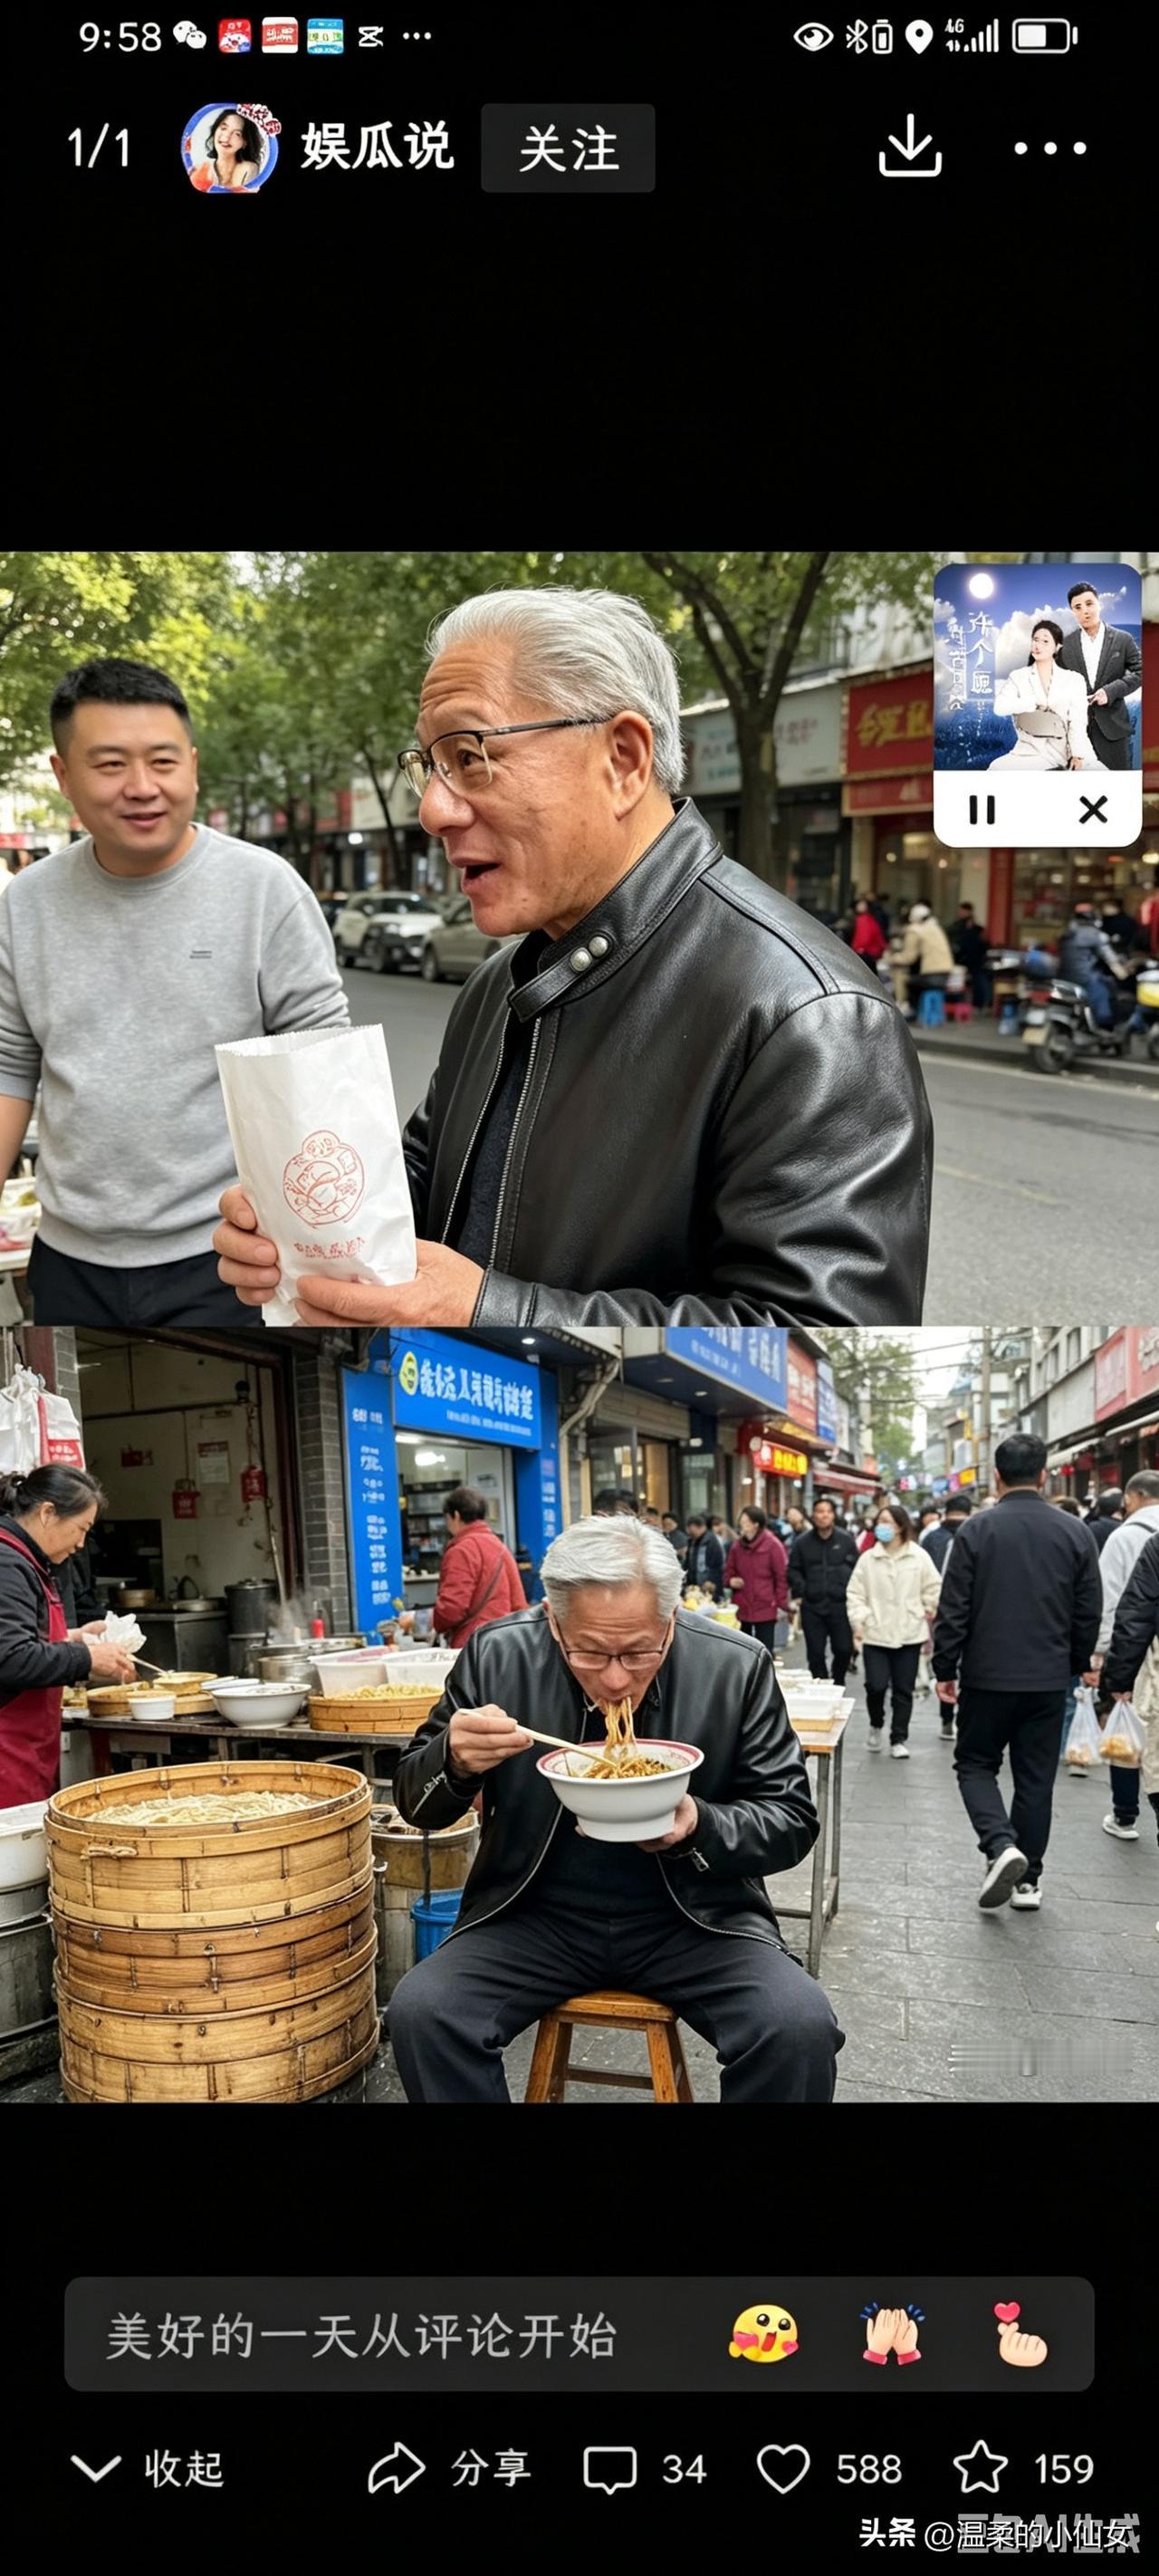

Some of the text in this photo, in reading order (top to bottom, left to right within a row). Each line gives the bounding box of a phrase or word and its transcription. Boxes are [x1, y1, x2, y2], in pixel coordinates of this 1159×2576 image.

[80, 22, 162, 53] 9:58
[68, 123, 129, 168] 1/1
[301, 120, 455, 170] 娱瓜说
[519, 123, 620, 173] 关注
[106, 2312, 617, 2360] 美好的一天从评论开始
[145, 2448, 225, 2489] 收起
[451, 2447, 532, 2487] 分享
[662, 2454, 707, 2485] 34
[837, 2454, 903, 2485] 588
[1035, 2454, 1095, 2485] 159
